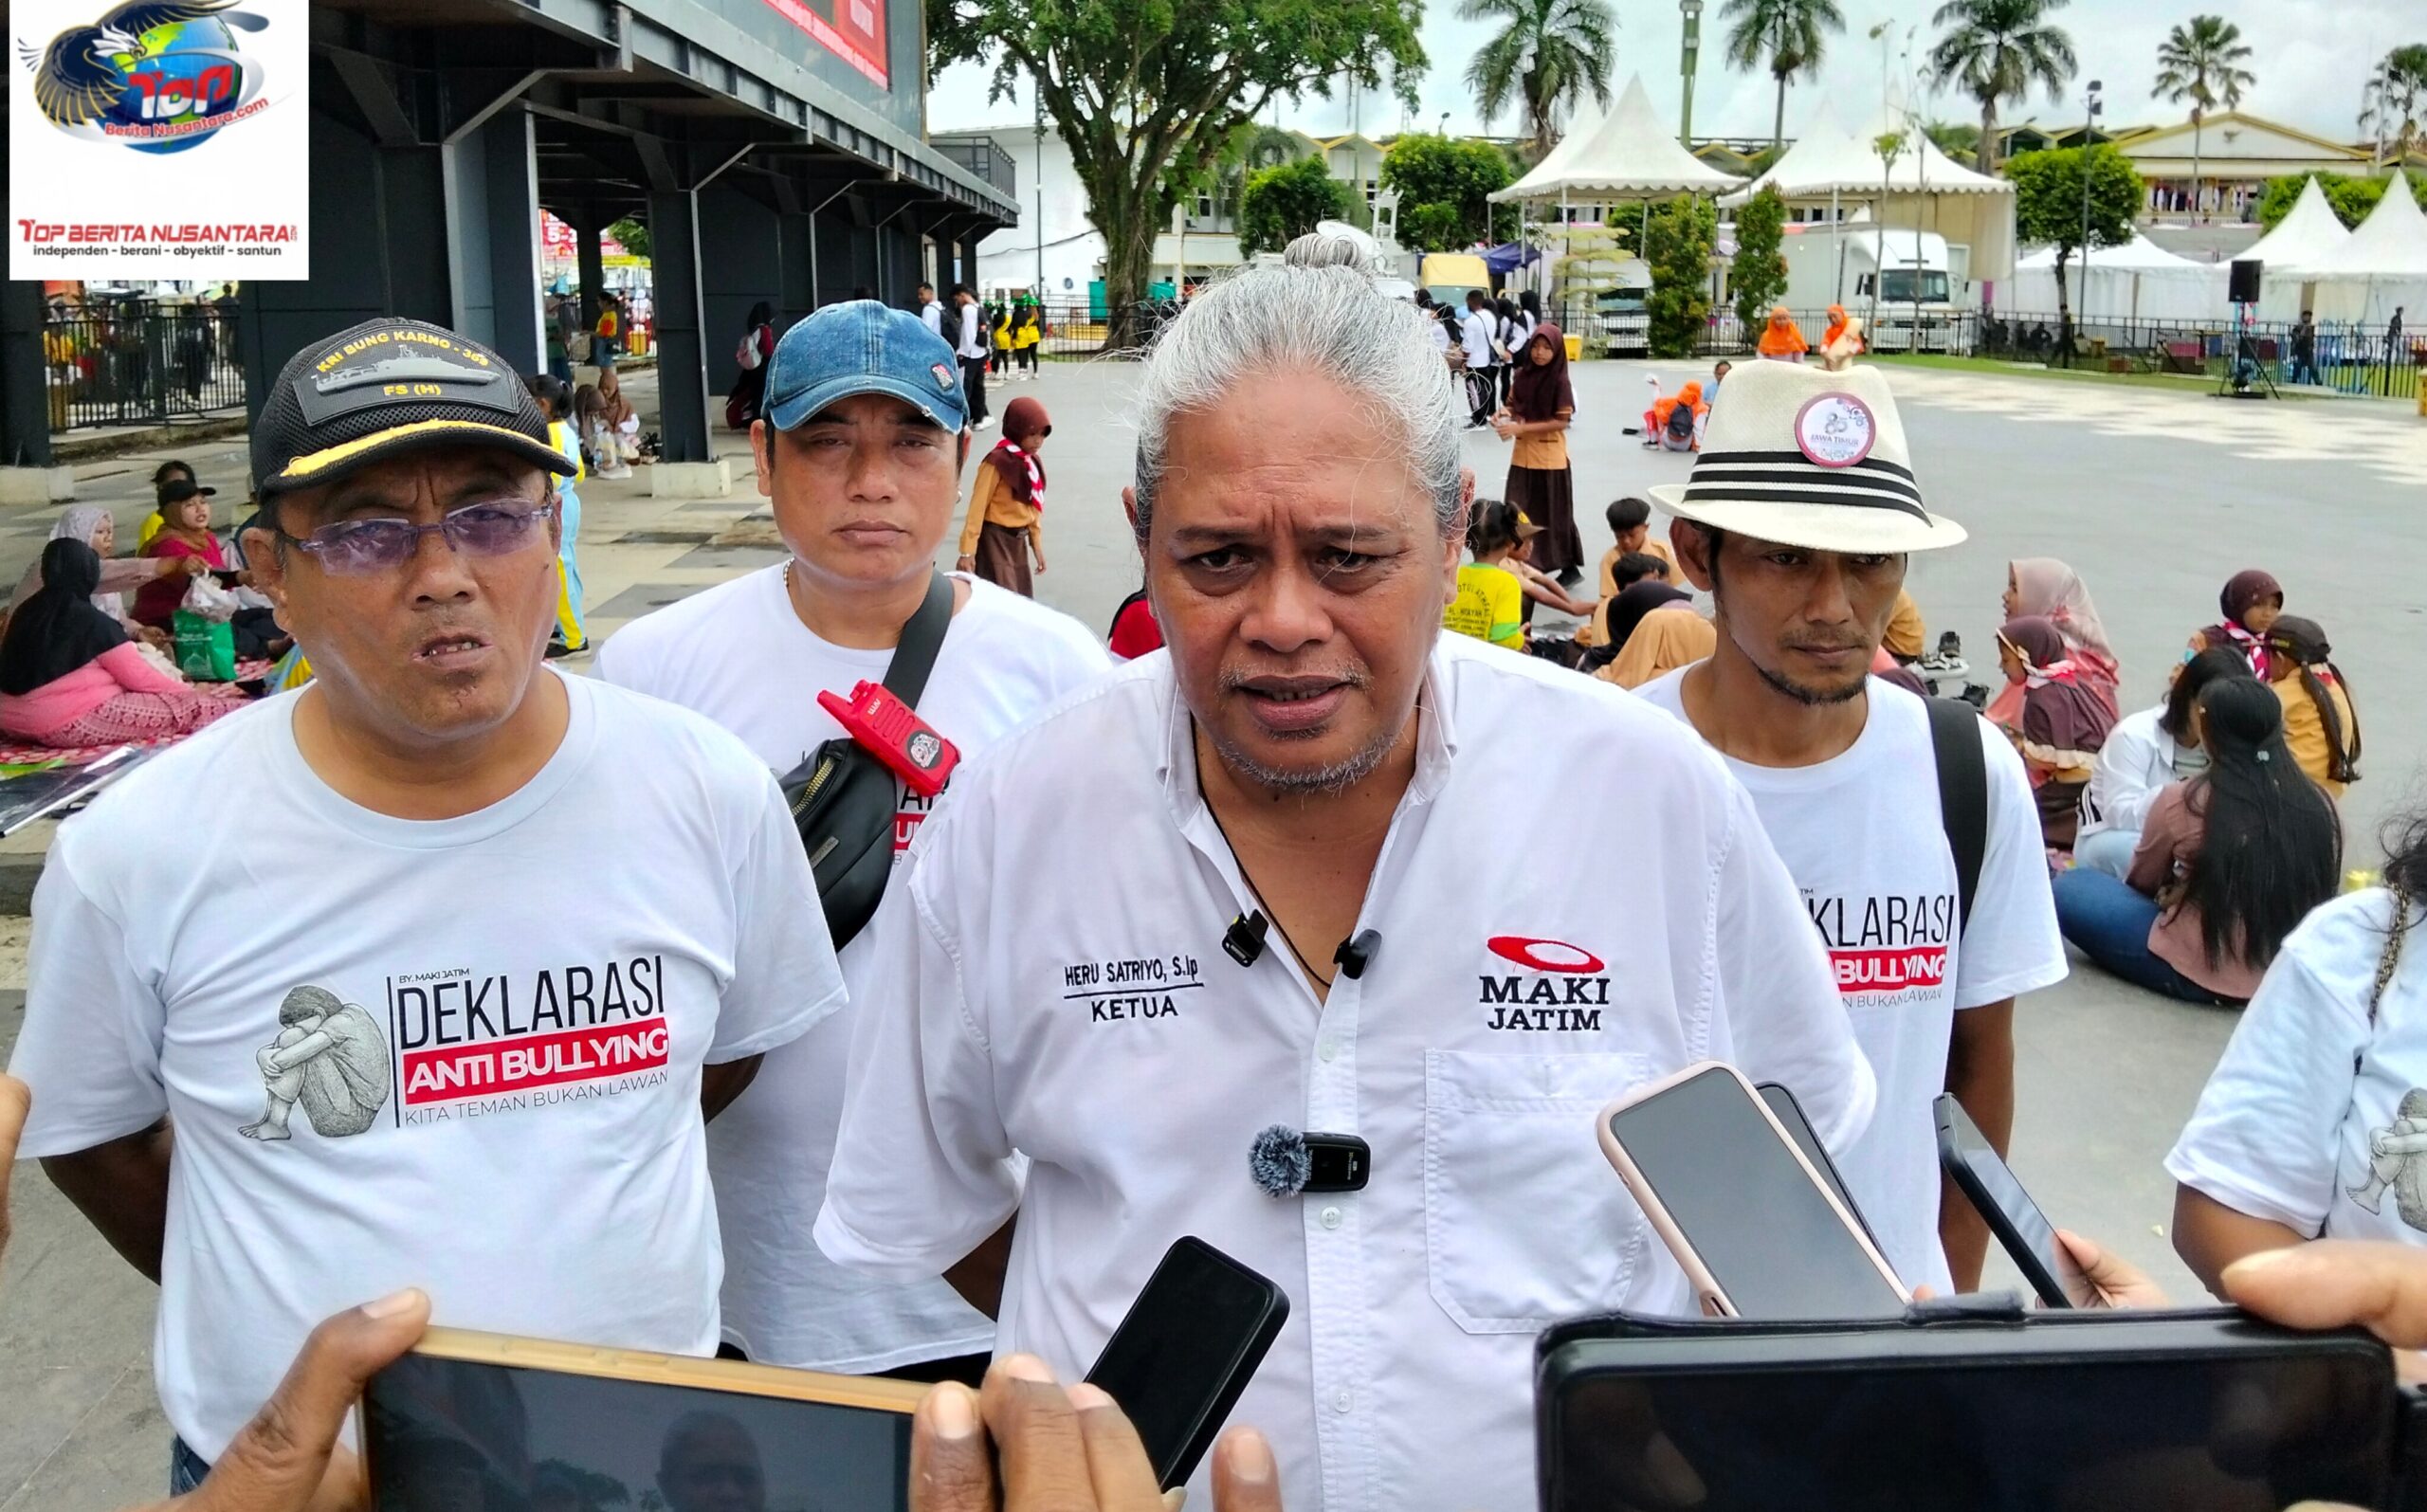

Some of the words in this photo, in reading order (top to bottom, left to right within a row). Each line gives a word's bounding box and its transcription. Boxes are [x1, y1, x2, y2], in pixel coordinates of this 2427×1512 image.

[317, 352, 343, 373] KRI
[342, 333, 390, 355] BUNG
[393, 331, 450, 349] KARNO
[383, 384, 408, 395] FS
[414, 384, 442, 395] (H)
[1834, 436, 1859, 446] TIMUR
[1808, 895, 1955, 947] KLARASI
[415, 971, 441, 982] MAKI
[442, 967, 470, 978] JATIM
[1065, 963, 1100, 987] HERU
[1106, 957, 1168, 983] SATRIYO,
[1834, 954, 1946, 984] BULLYING
[396, 955, 665, 1050] DEKLARASI
[1479, 975, 1611, 1006] MAKI
[1856, 994, 1902, 1008] BUKAN
[1091, 995, 1179, 1023] KETUA
[1487, 1008, 1602, 1030] JATIM
[407, 1053, 495, 1094] ANTI
[502, 1028, 669, 1081] BULLYING
[405, 1105, 450, 1126] KITA
[455, 1096, 526, 1119] TEMAN
[533, 1084, 602, 1107] BUKAN
[608, 1070, 669, 1095] LAWAN
